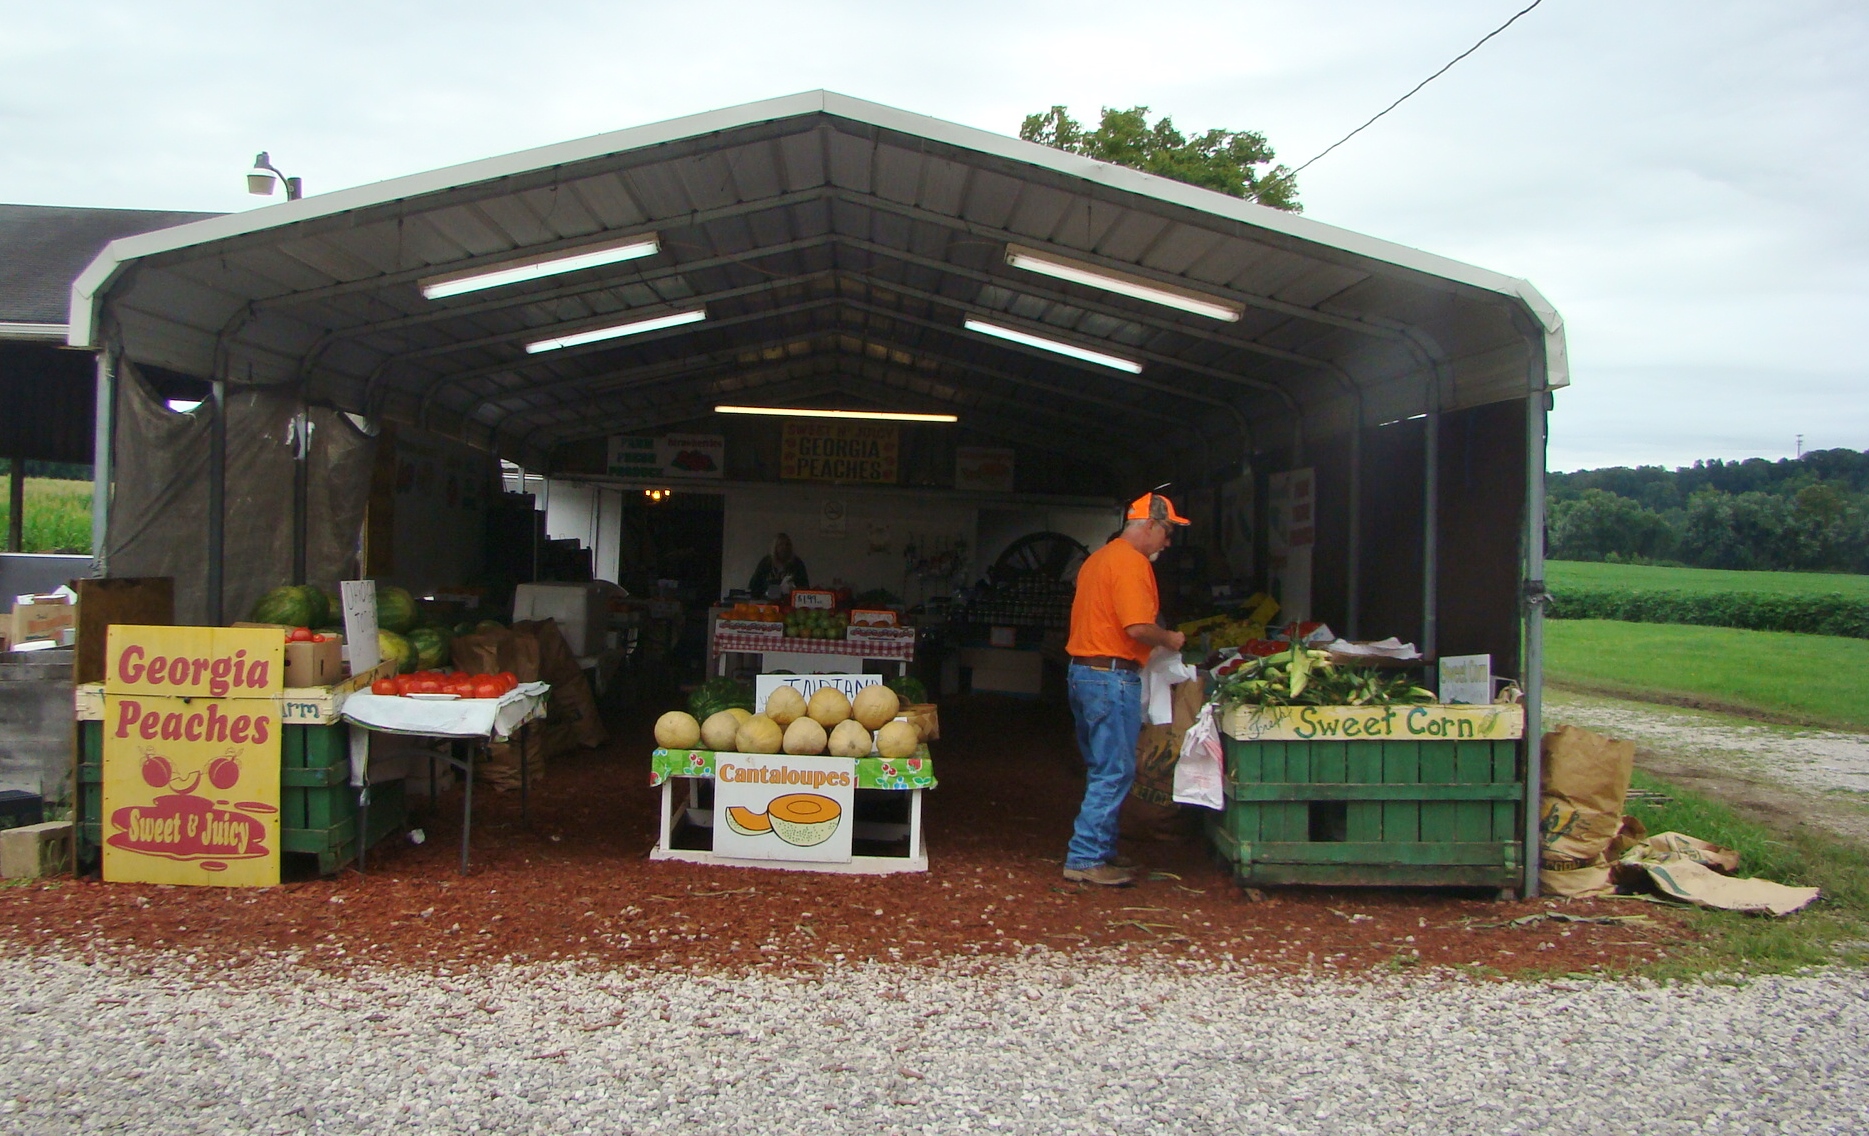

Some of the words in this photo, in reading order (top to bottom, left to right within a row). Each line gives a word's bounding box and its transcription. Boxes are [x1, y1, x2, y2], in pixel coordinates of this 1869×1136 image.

[799, 437, 880, 458] GEORGIA
[797, 458, 882, 480] PEACHES
[118, 644, 270, 697] Georgia
[115, 700, 270, 744] Peaches
[1294, 706, 1397, 739] Sweet
[1406, 707, 1474, 738] Corn
[719, 763, 850, 789] Cantaloupes
[127, 809, 182, 843] Sweet
[186, 813, 199, 839] &
[201, 811, 250, 854] Juicy
